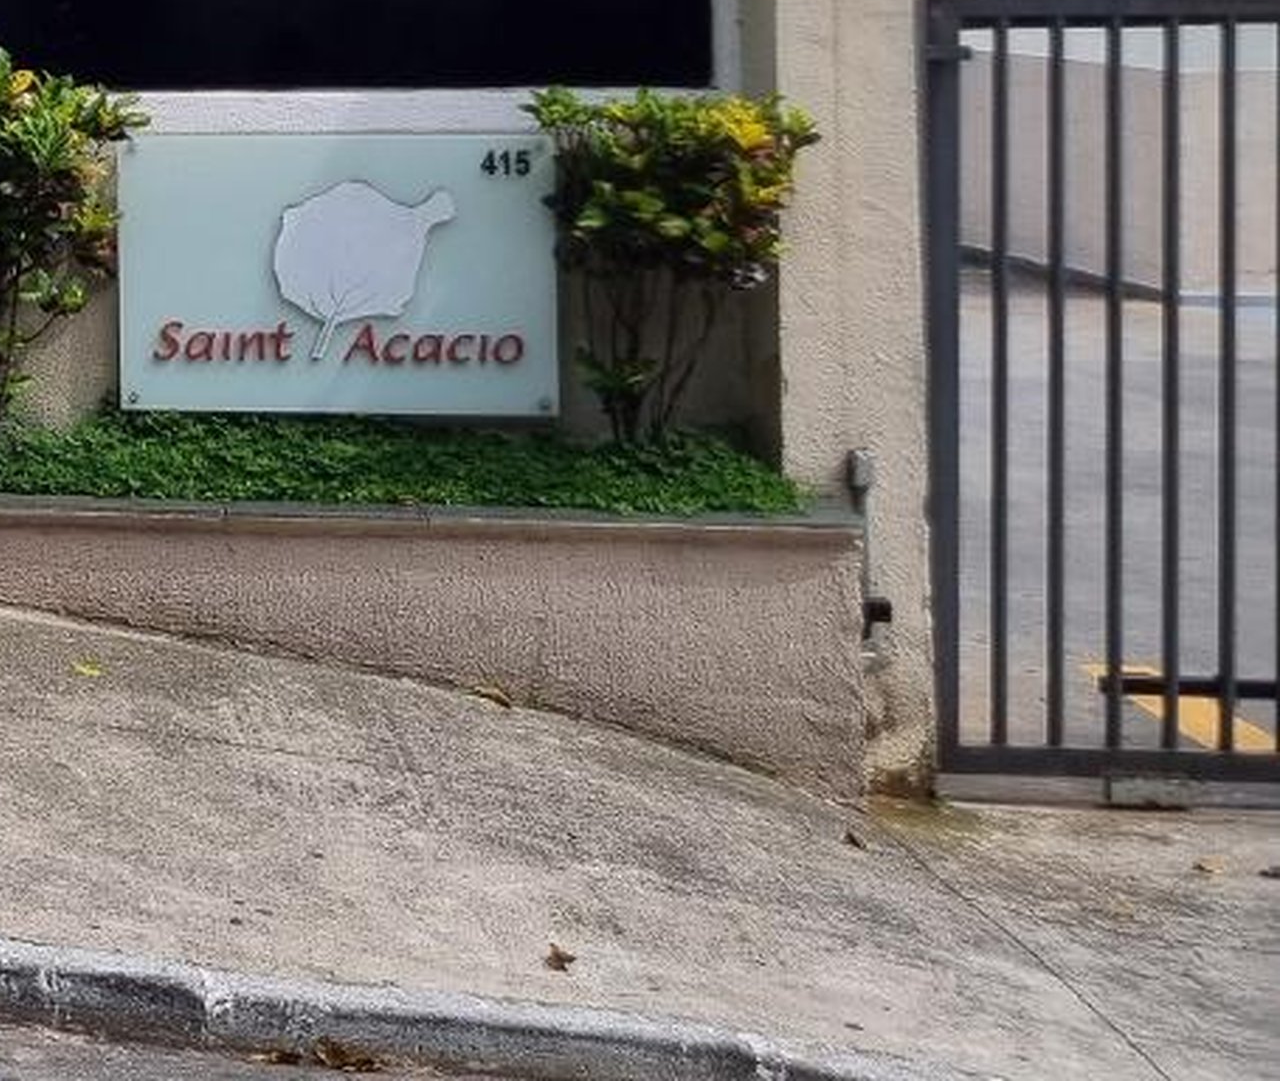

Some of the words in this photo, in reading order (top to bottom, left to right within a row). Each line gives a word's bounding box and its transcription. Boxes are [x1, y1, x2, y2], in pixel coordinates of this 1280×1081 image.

[479, 150, 531, 177] 415
[153, 321, 294, 363] Saint
[343, 324, 525, 365] Acacio
